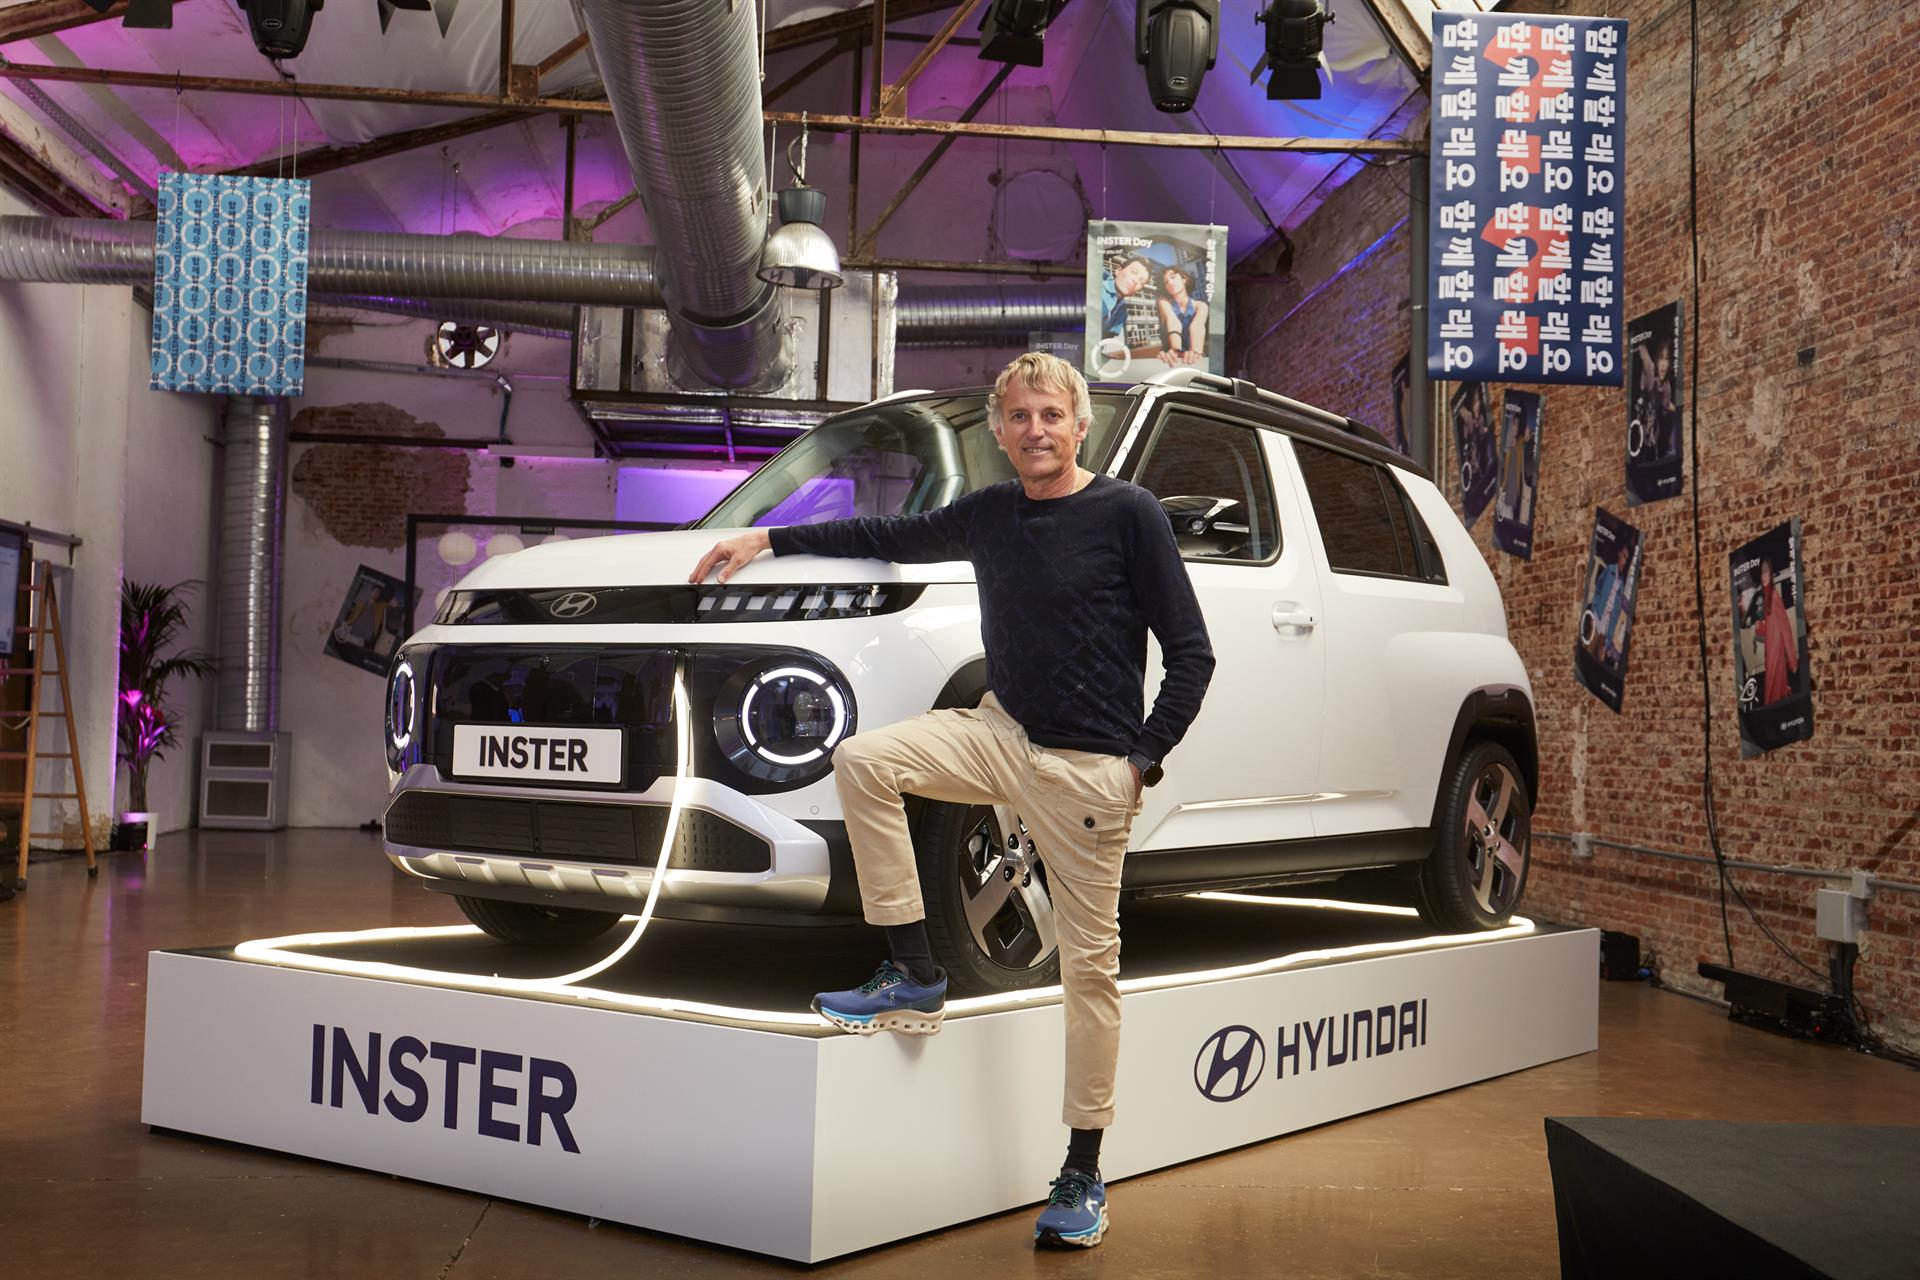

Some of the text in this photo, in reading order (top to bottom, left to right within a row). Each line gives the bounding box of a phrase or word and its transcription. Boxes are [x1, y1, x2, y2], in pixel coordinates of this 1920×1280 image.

[1441, 19, 1478, 191] 함께할래요
[1495, 21, 1531, 192] 함께할래요
[1539, 23, 1575, 193] 함께할래요
[1583, 26, 1618, 196] 함께할래요
[212, 189, 220, 218] INSTER
[246, 191, 254, 220] INSTER
[282, 193, 290, 222] INSTER
[174, 236, 182, 265] INSTER
[210, 238, 218, 267] INSTER
[244, 240, 252, 269] INSTER
[280, 241, 288, 270] INSTER
[1097, 236, 1153, 248] INSTER Day
[172, 285, 180, 314] INSTER
[1438, 200, 1476, 372] 함께할래요
[1493, 202, 1529, 374] 함께할래요
[1538, 203, 1573, 375] 함께할래요
[1580, 206, 1615, 377] 함께할래요
[170, 334, 178, 363] INSTER
[241, 337, 249, 366] INSTER
[277, 339, 285, 368] INSTER
[1063, 343, 1080, 351] Day
[479, 735, 589, 773] INSTER
[1277, 998, 1428, 1081] HYUNDAI
[311, 1023, 581, 1155] INSTER
